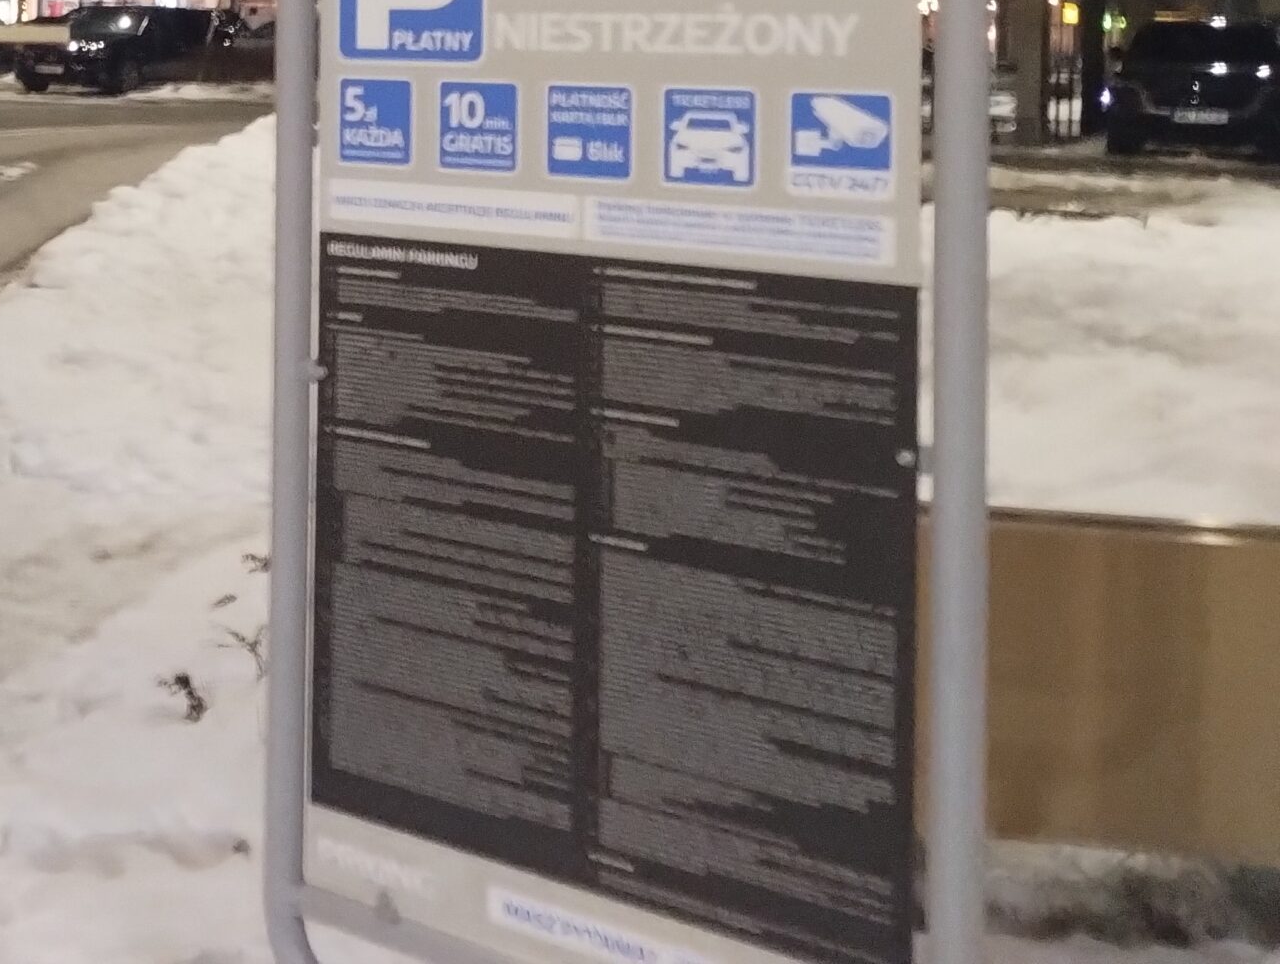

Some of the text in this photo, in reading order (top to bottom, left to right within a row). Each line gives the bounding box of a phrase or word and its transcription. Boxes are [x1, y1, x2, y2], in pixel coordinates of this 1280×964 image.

[392, 30, 474, 52] PŁATNY
[494, 2, 861, 57] NIESTRZEŻONY
[443, 91, 485, 129] 10
